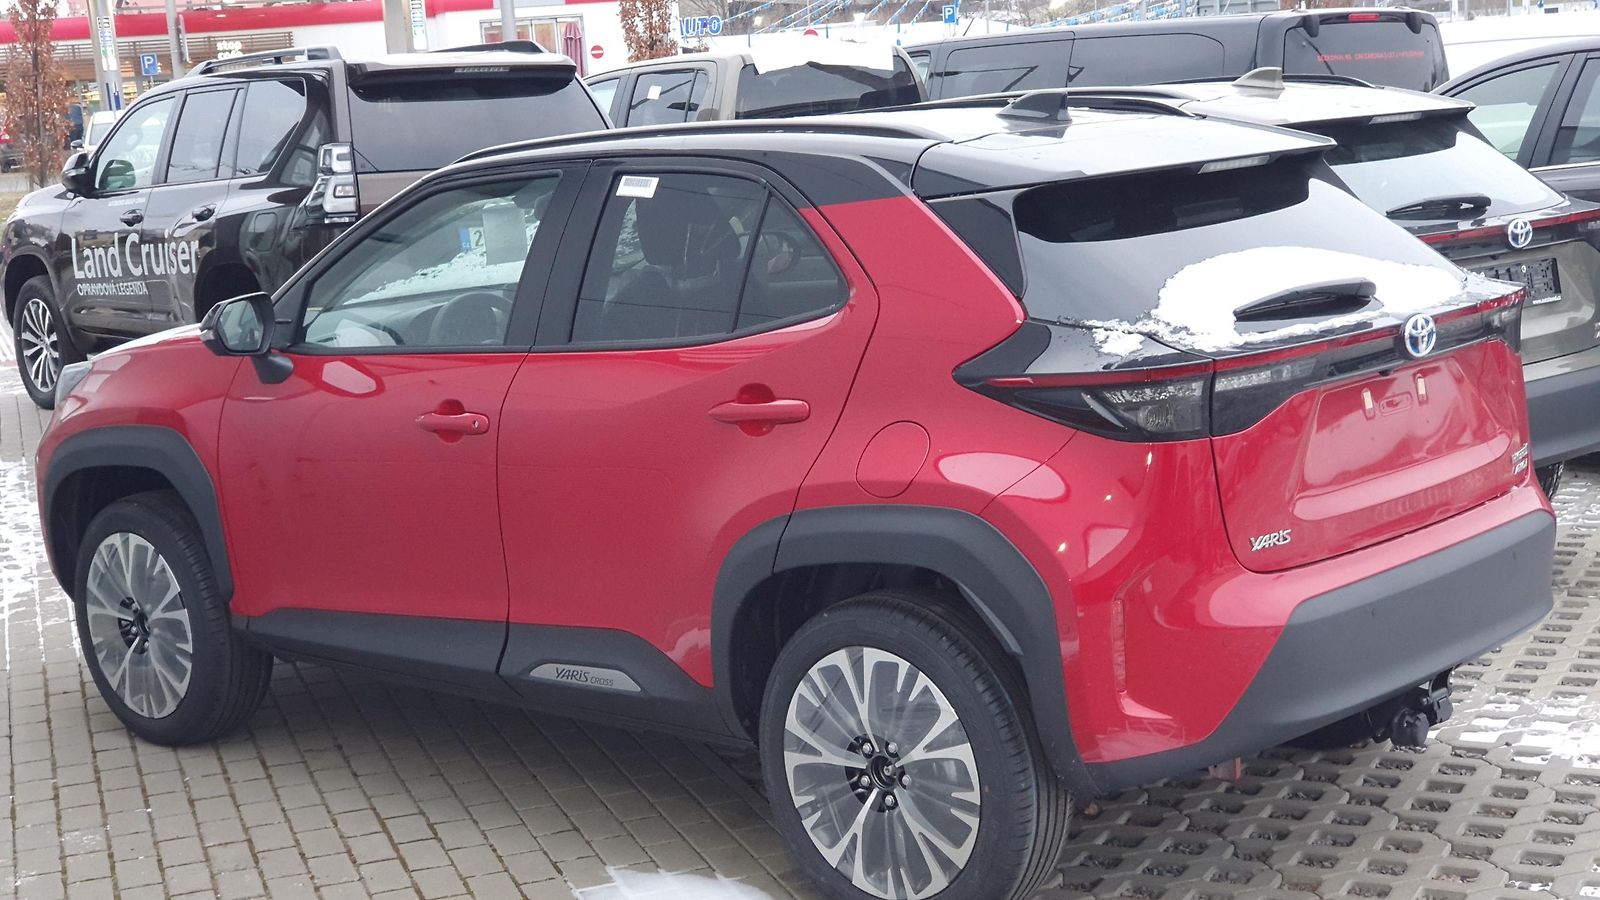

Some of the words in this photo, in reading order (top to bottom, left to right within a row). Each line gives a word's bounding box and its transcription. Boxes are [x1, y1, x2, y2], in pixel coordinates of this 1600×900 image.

[216, 40, 242, 51] stop
[71, 232, 122, 279] Land
[125, 228, 199, 276] Cruiser
[76, 280, 117, 296] OPRAVDOVÁ
[115, 280, 149, 296] LEGENDA
[590, 676, 614, 687] CROSS
